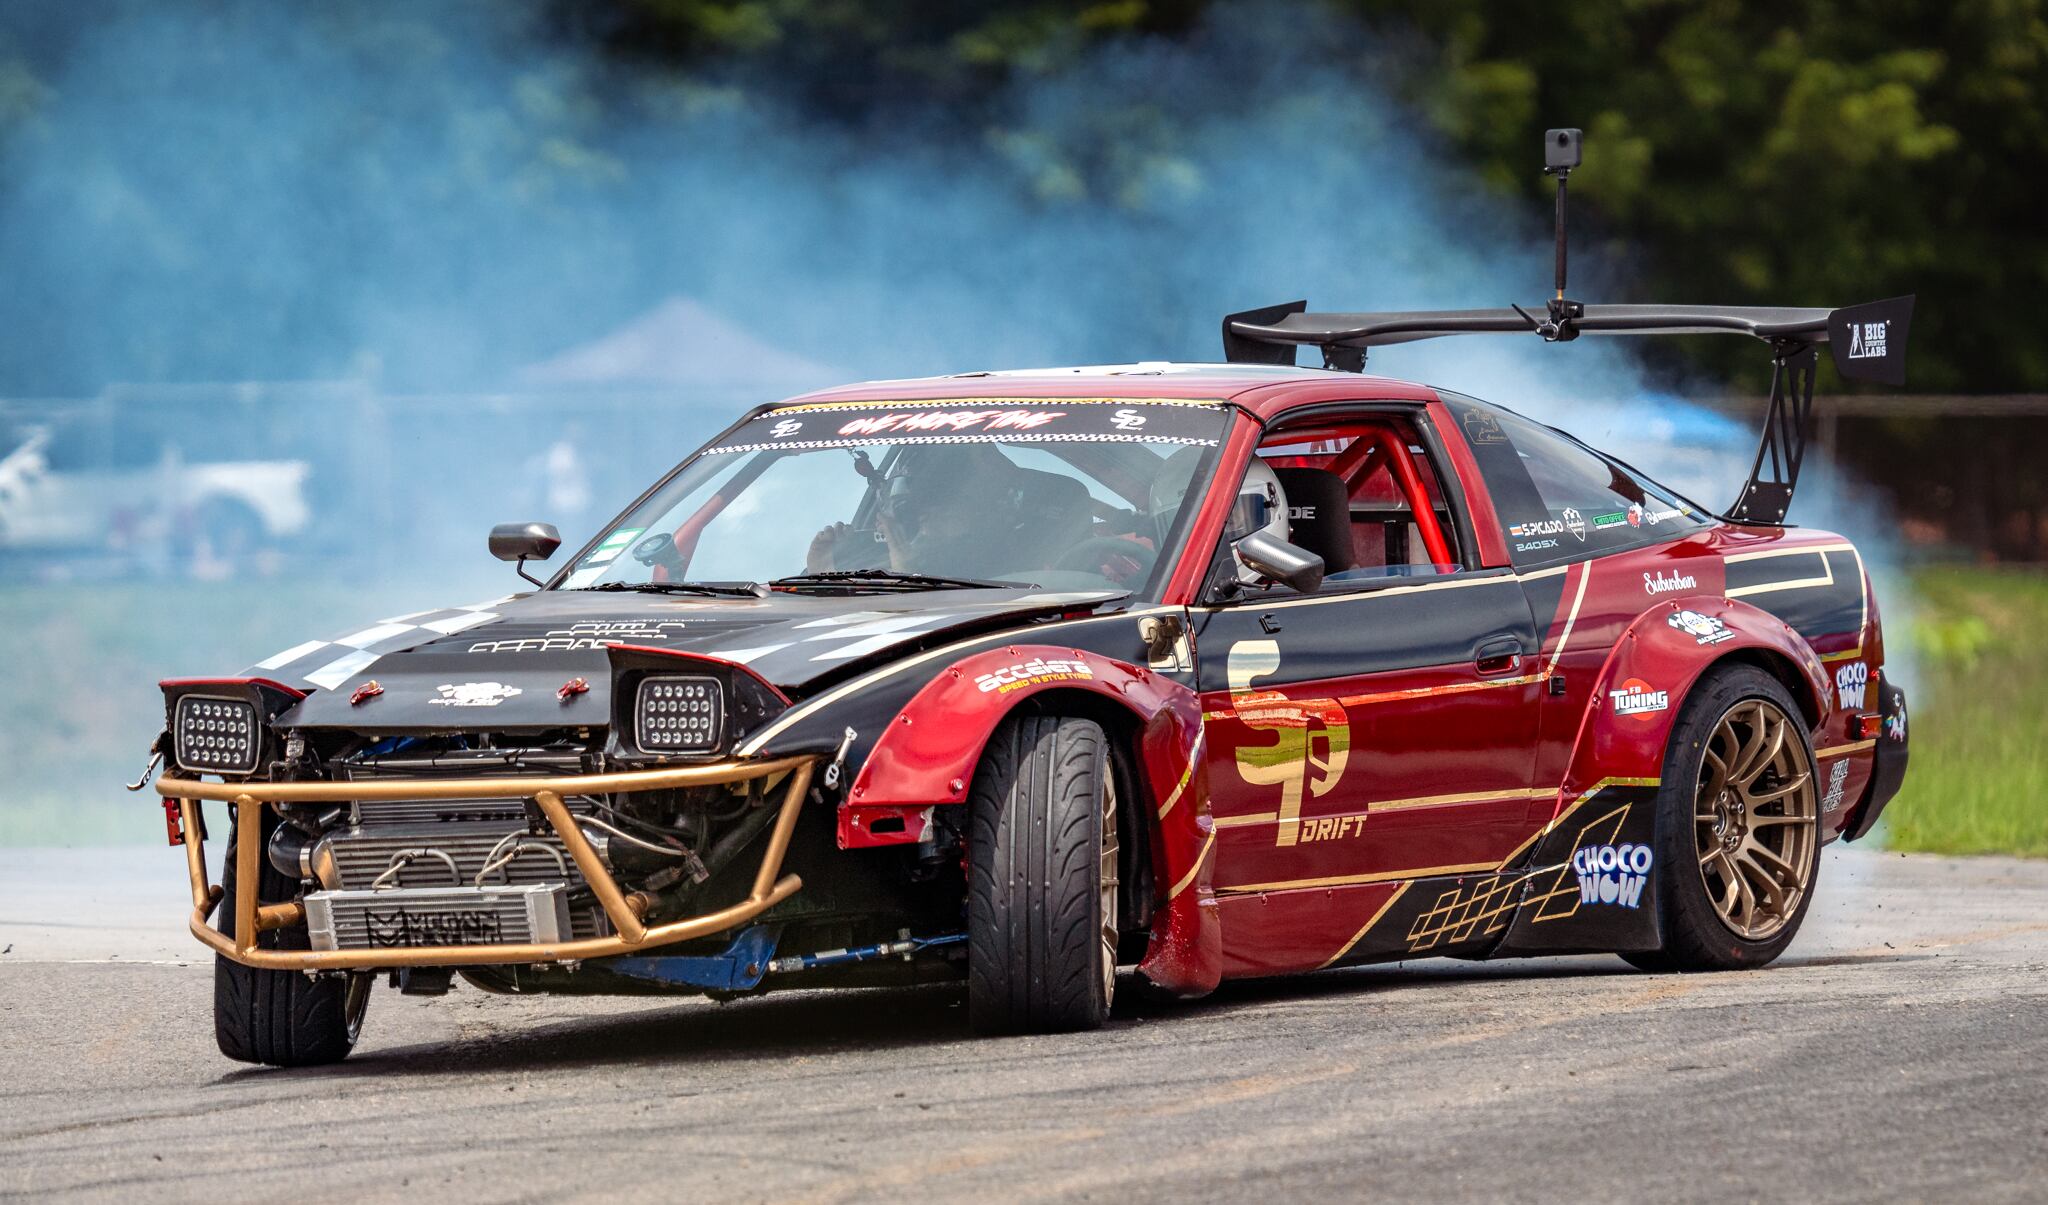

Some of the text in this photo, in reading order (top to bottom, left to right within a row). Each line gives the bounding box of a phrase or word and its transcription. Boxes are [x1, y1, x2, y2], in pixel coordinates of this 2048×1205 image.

[1864, 323, 1886, 340] BIG
[1865, 347, 1887, 358] LABS
[1521, 519, 1564, 537] S.PICADO
[1515, 538, 1559, 552] 240SX
[1643, 569, 1697, 595] Suburban
[974, 657, 1093, 693] accelera
[998, 679, 1031, 694] SPEED
[1836, 662, 1868, 687] CHOCO
[1838, 684, 1866, 710] WOW
[1300, 814, 1368, 843] DRIFT
[1573, 843, 1653, 875] CHOCO
[1578, 872, 1647, 908] WOW
